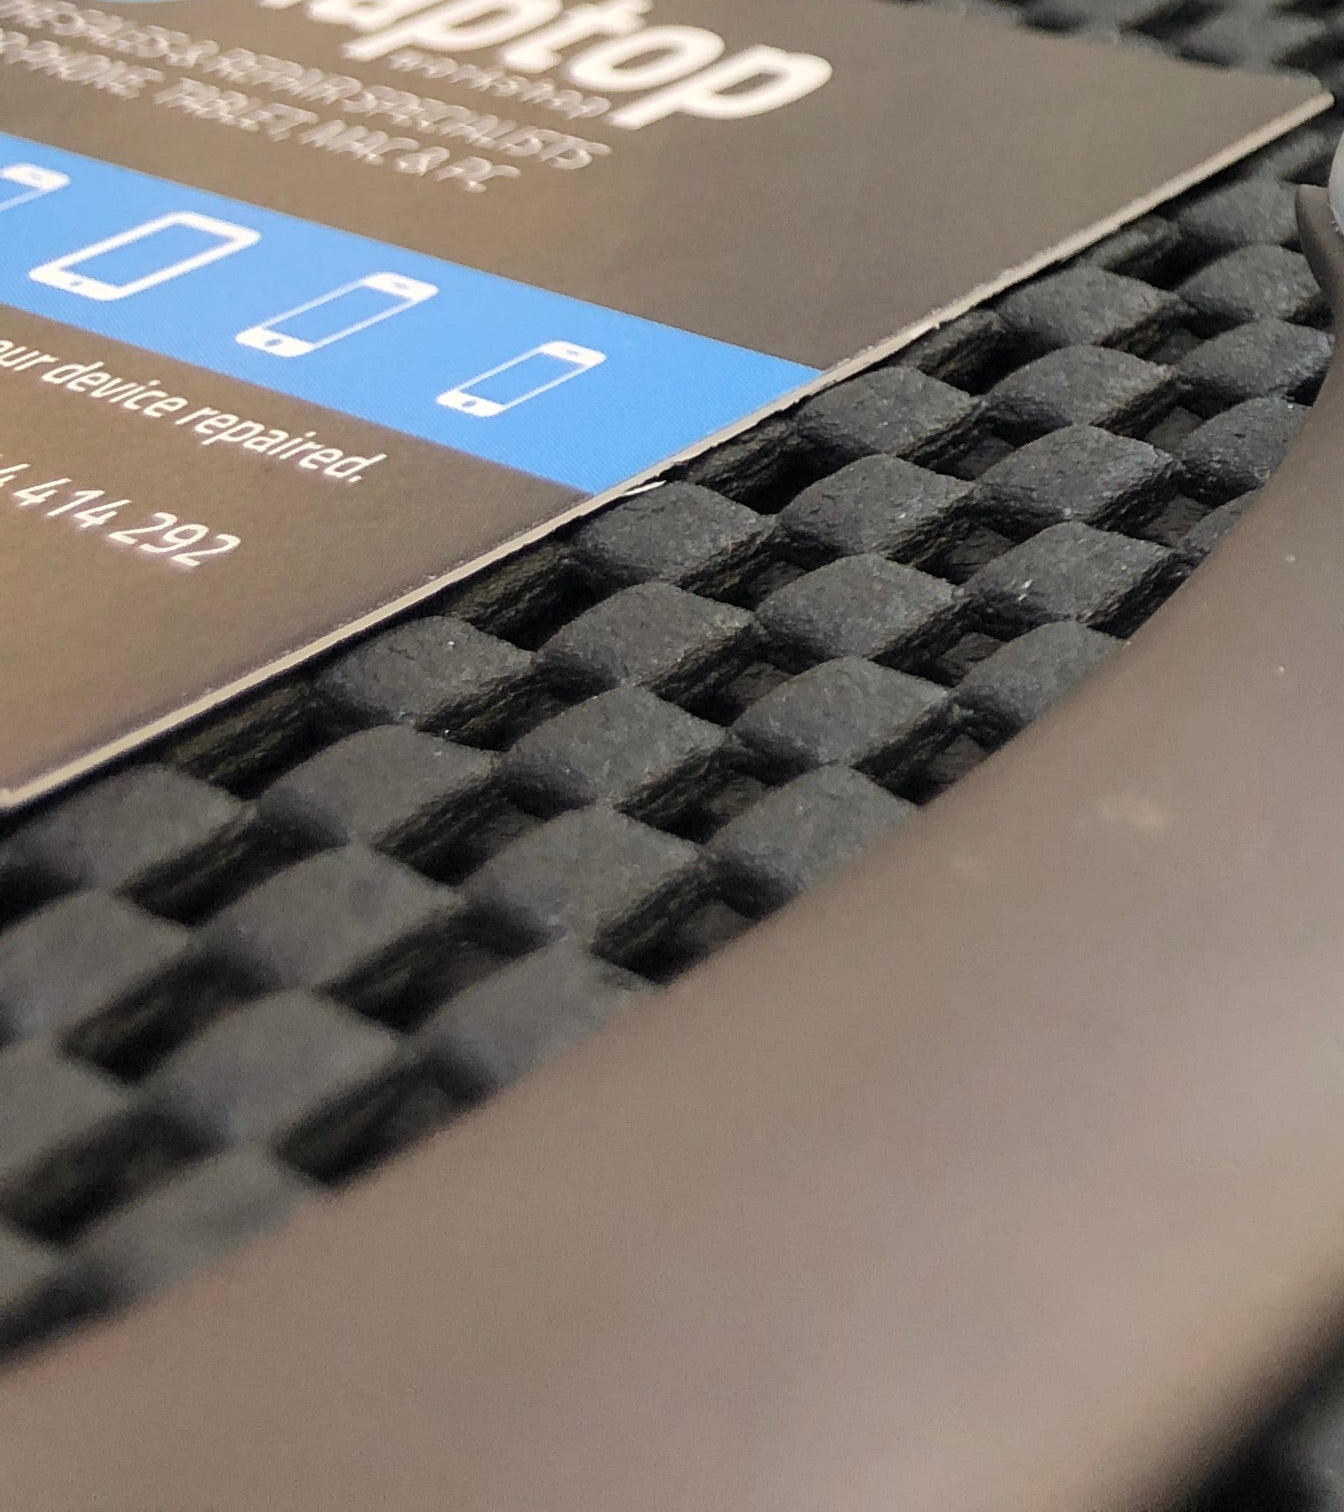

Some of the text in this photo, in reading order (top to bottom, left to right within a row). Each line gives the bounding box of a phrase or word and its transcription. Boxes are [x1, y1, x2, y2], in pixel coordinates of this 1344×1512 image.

[341, 85, 613, 171] SPECIALISTS
[436, 156, 522, 193] PC
[41, 361, 188, 418] device
[175, 406, 388, 484] repaired.
[13, 477, 132, 528] 414
[107, 511, 242, 567] 292
